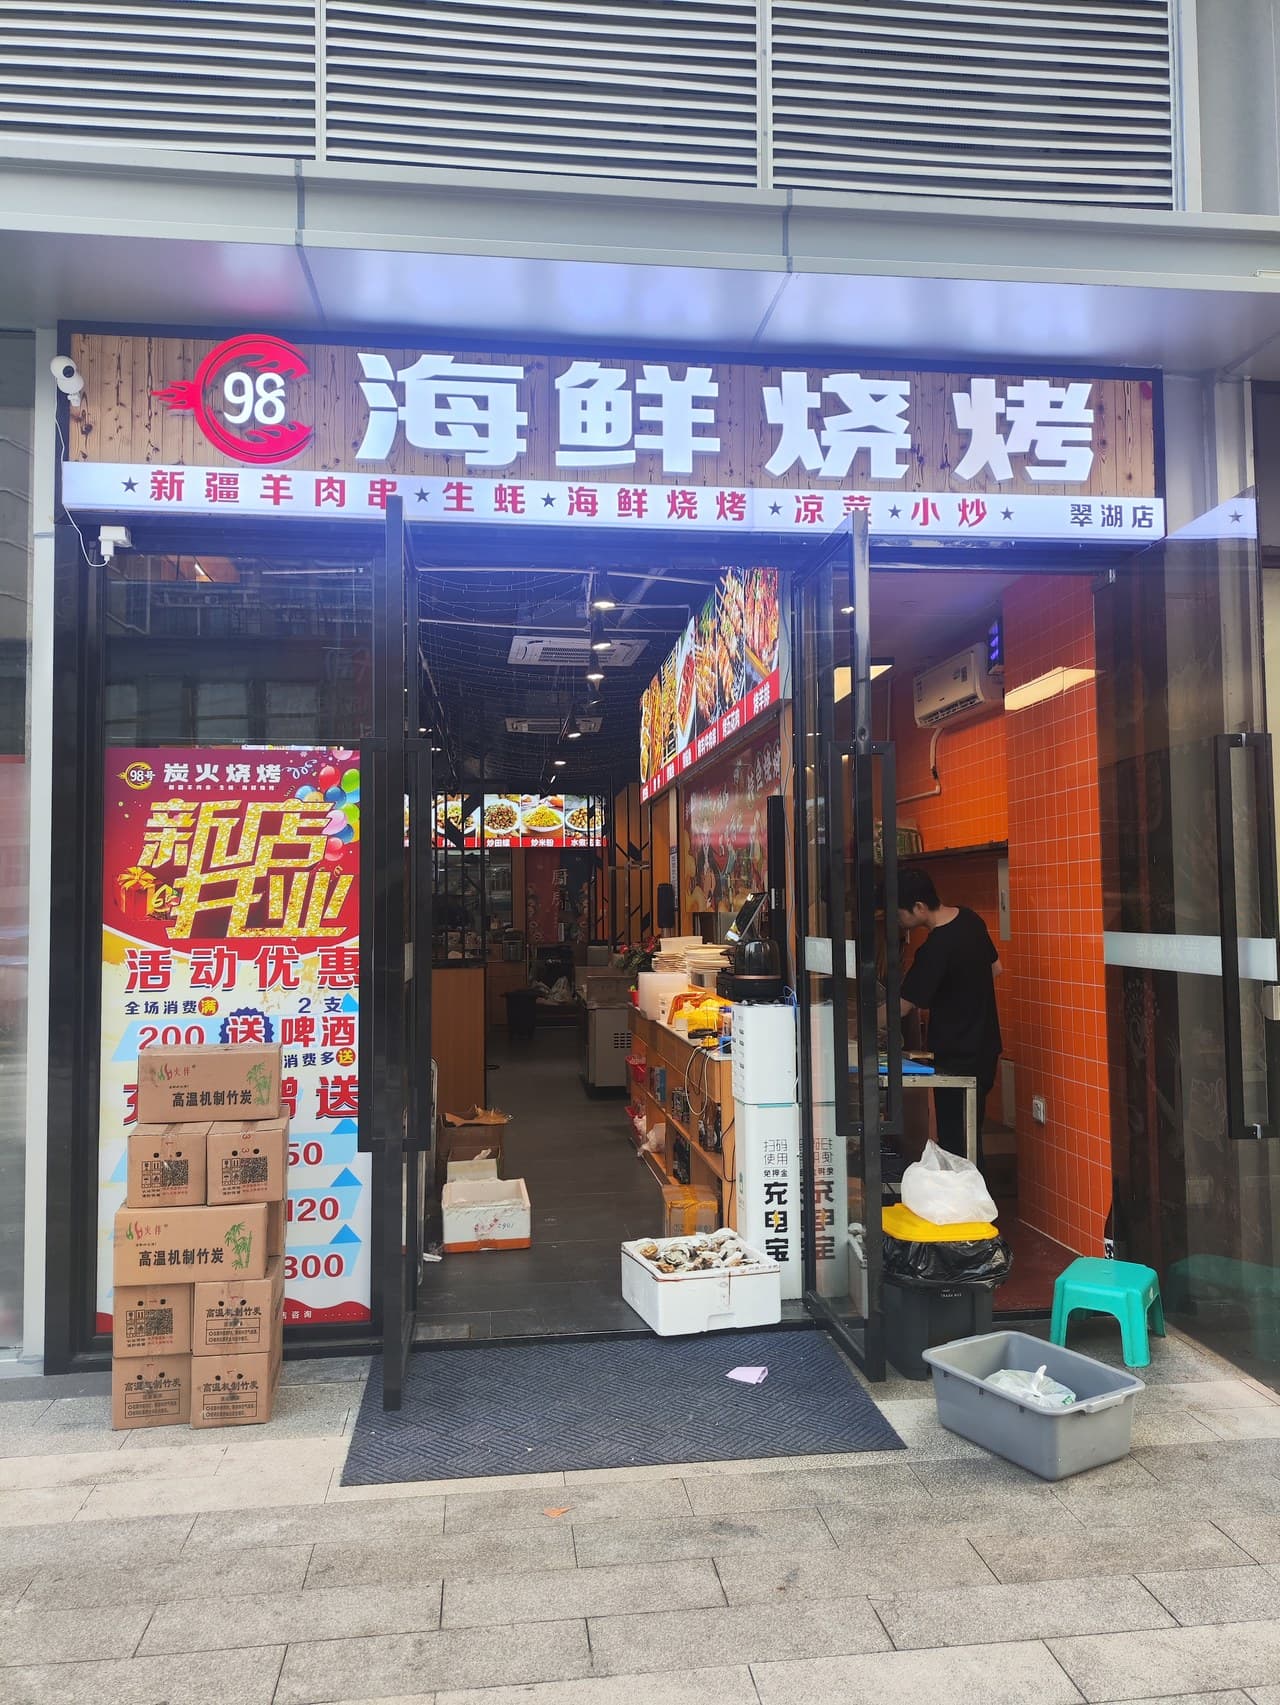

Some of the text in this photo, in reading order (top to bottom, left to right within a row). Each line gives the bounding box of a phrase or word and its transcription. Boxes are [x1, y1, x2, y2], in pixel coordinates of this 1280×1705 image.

[223, 371, 287, 425] 98
[355, 352, 1094, 481] 海鲜烧烤
[150, 470, 1154, 530] 新疆羊肉串 生蚝 海鲜烧烤 凉菜 小炒 翠湖店
[164, 763, 281, 783] 炭火烧烤
[137, 799, 334, 869] 新店
[166, 866, 354, 939] 开业
[125, 946, 359, 992] 活动优惠
[139, 1015, 355, 1049] 200 送 啤酒
[172, 1089, 252, 1107] 高温机制竹炭
[764, 1138, 787, 1152] 扫码
[764, 1152, 788, 1165] 使用
[763, 1181, 789, 1261] 充电宝
[139, 1247, 224, 1267] 高温机制竹炭
